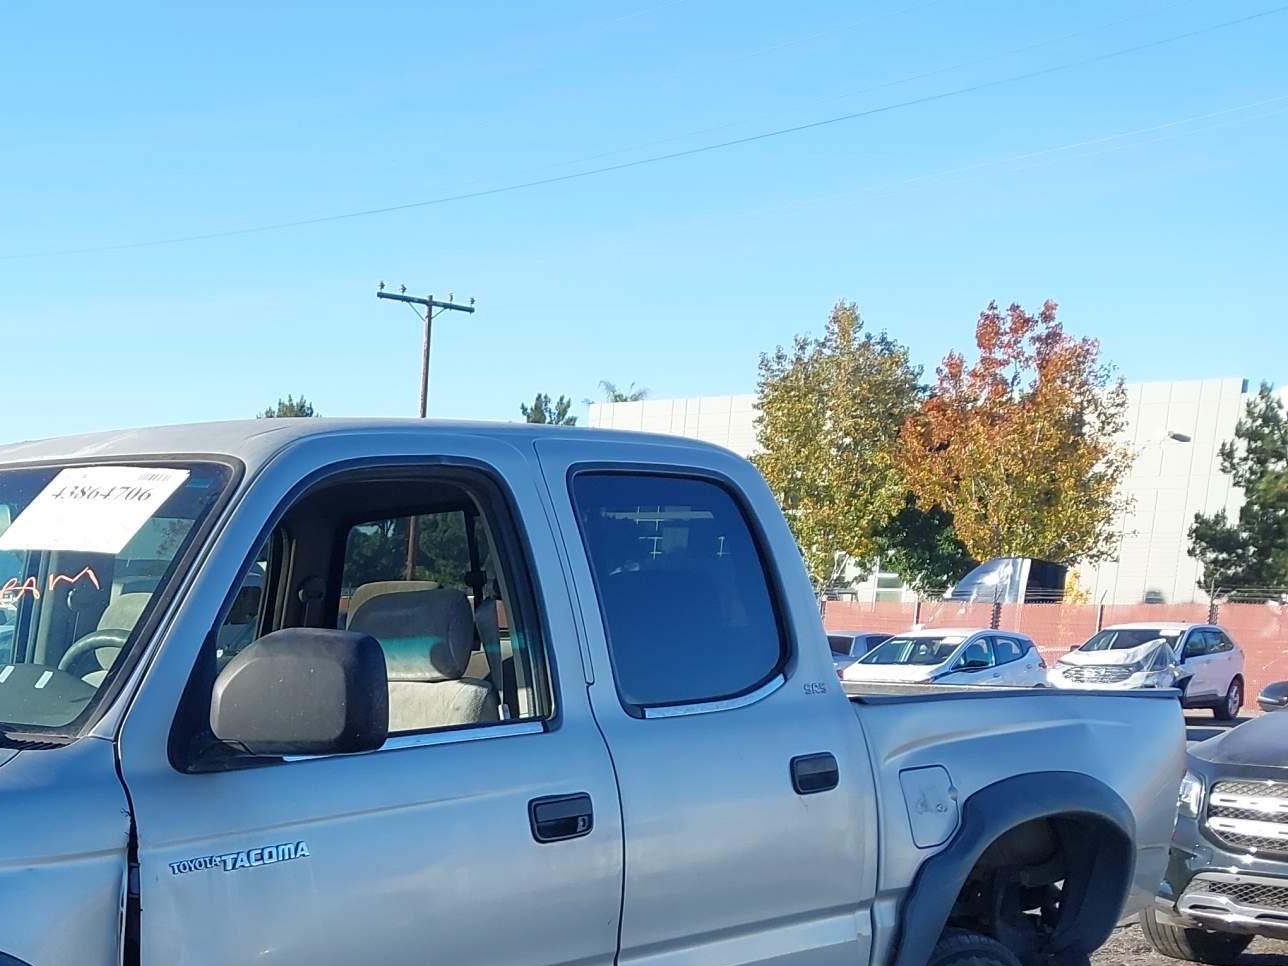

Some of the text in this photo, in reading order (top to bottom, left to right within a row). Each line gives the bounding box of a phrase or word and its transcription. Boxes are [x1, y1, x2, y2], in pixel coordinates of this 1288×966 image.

[52, 485, 153, 502] 43864706
[169, 840, 310, 876] TOYOTA TACOMA
